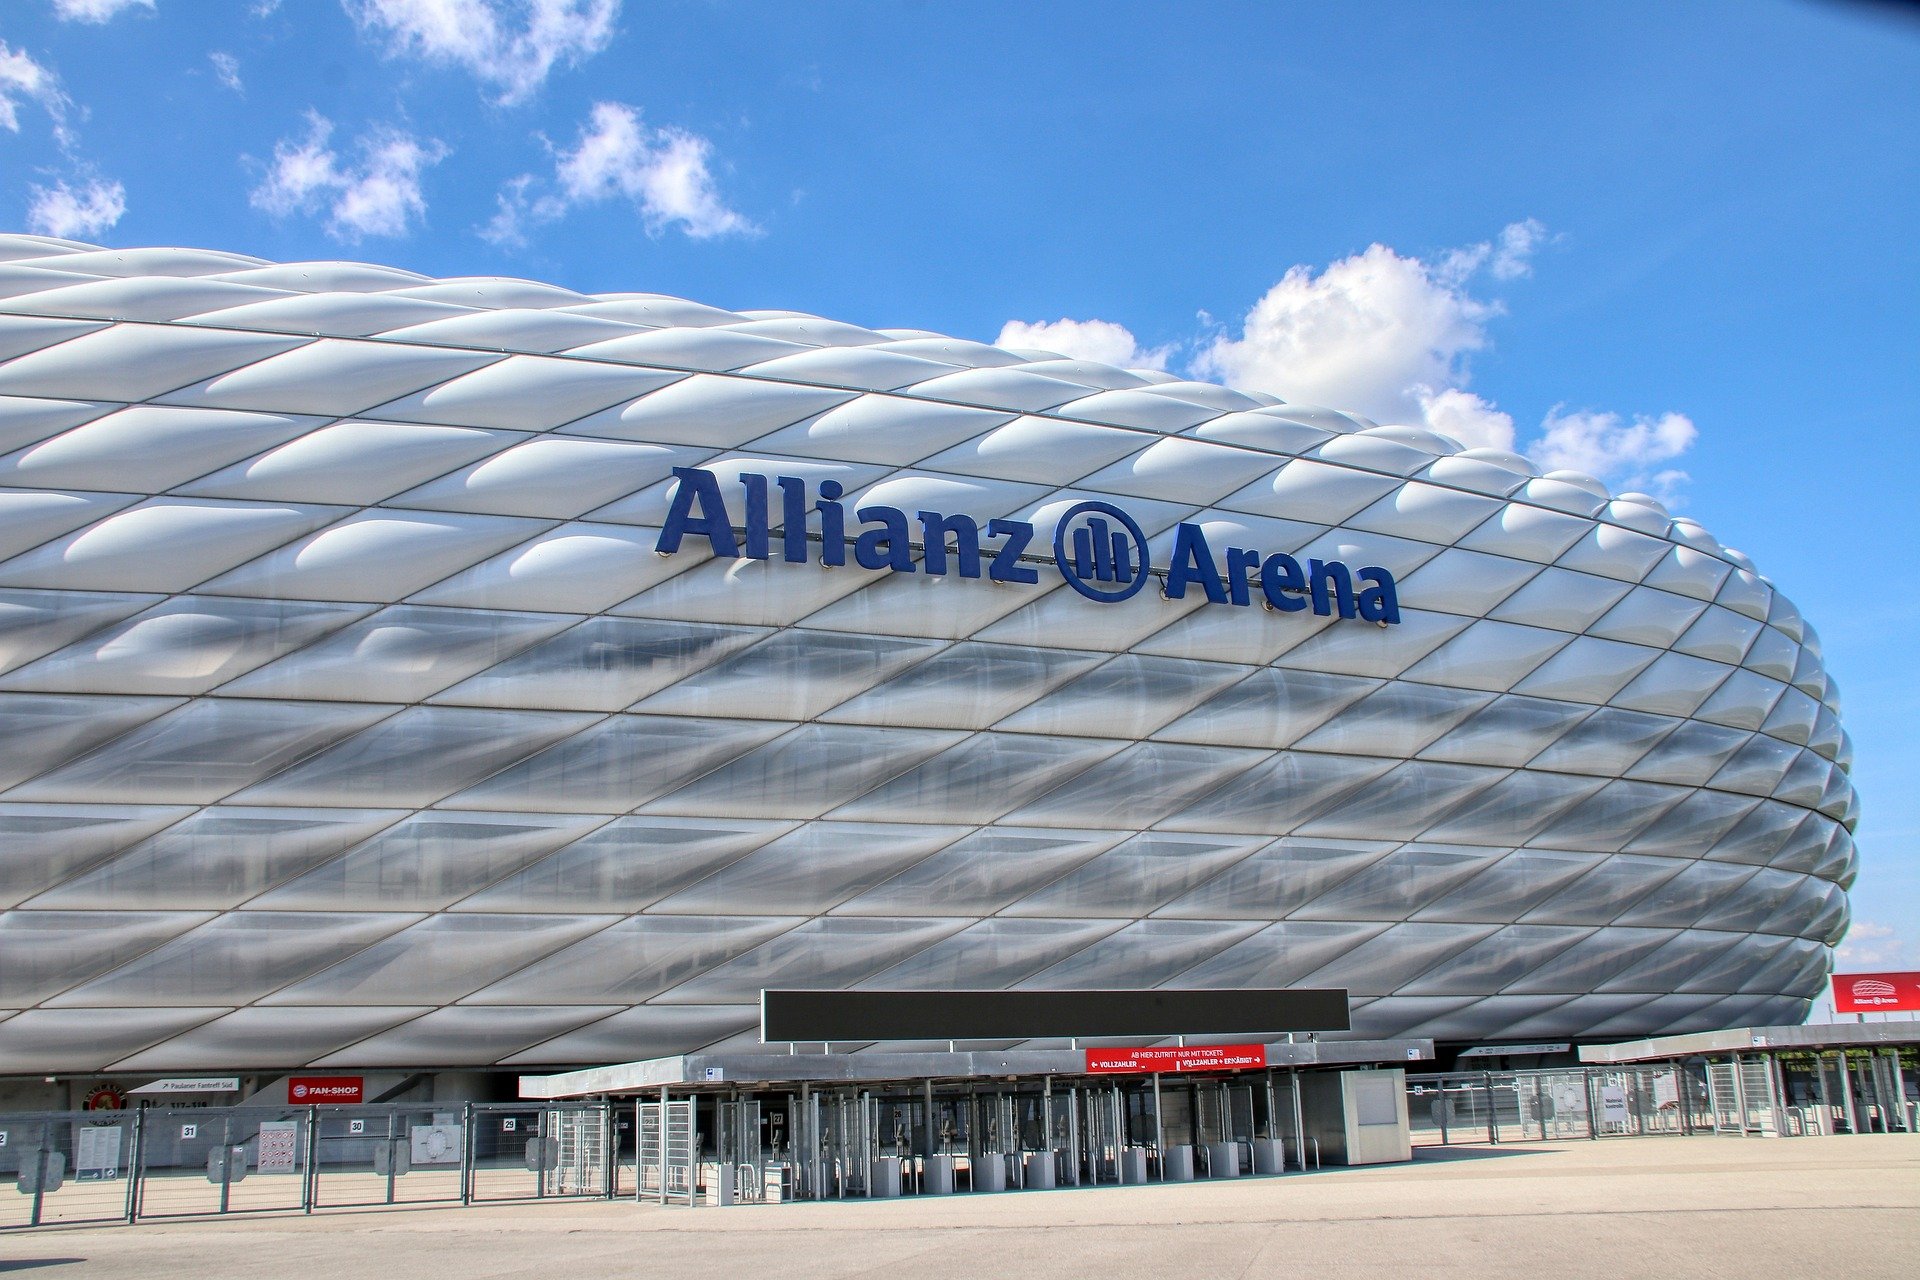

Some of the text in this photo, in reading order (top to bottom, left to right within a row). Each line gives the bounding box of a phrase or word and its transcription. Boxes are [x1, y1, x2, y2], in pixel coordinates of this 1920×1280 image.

[654, 465, 1401, 624] Allianz Arena
[1201, 1049, 1224, 1057] TICKETS
[1100, 1060, 1137, 1068] VOLLZAHLER
[309, 1086, 359, 1095] FAN-SHOP
[774, 1115, 781, 1123] 27
[352, 1122, 362, 1131] 30
[505, 1120, 514, 1128] 29
[184, 1127, 195, 1136] 31
